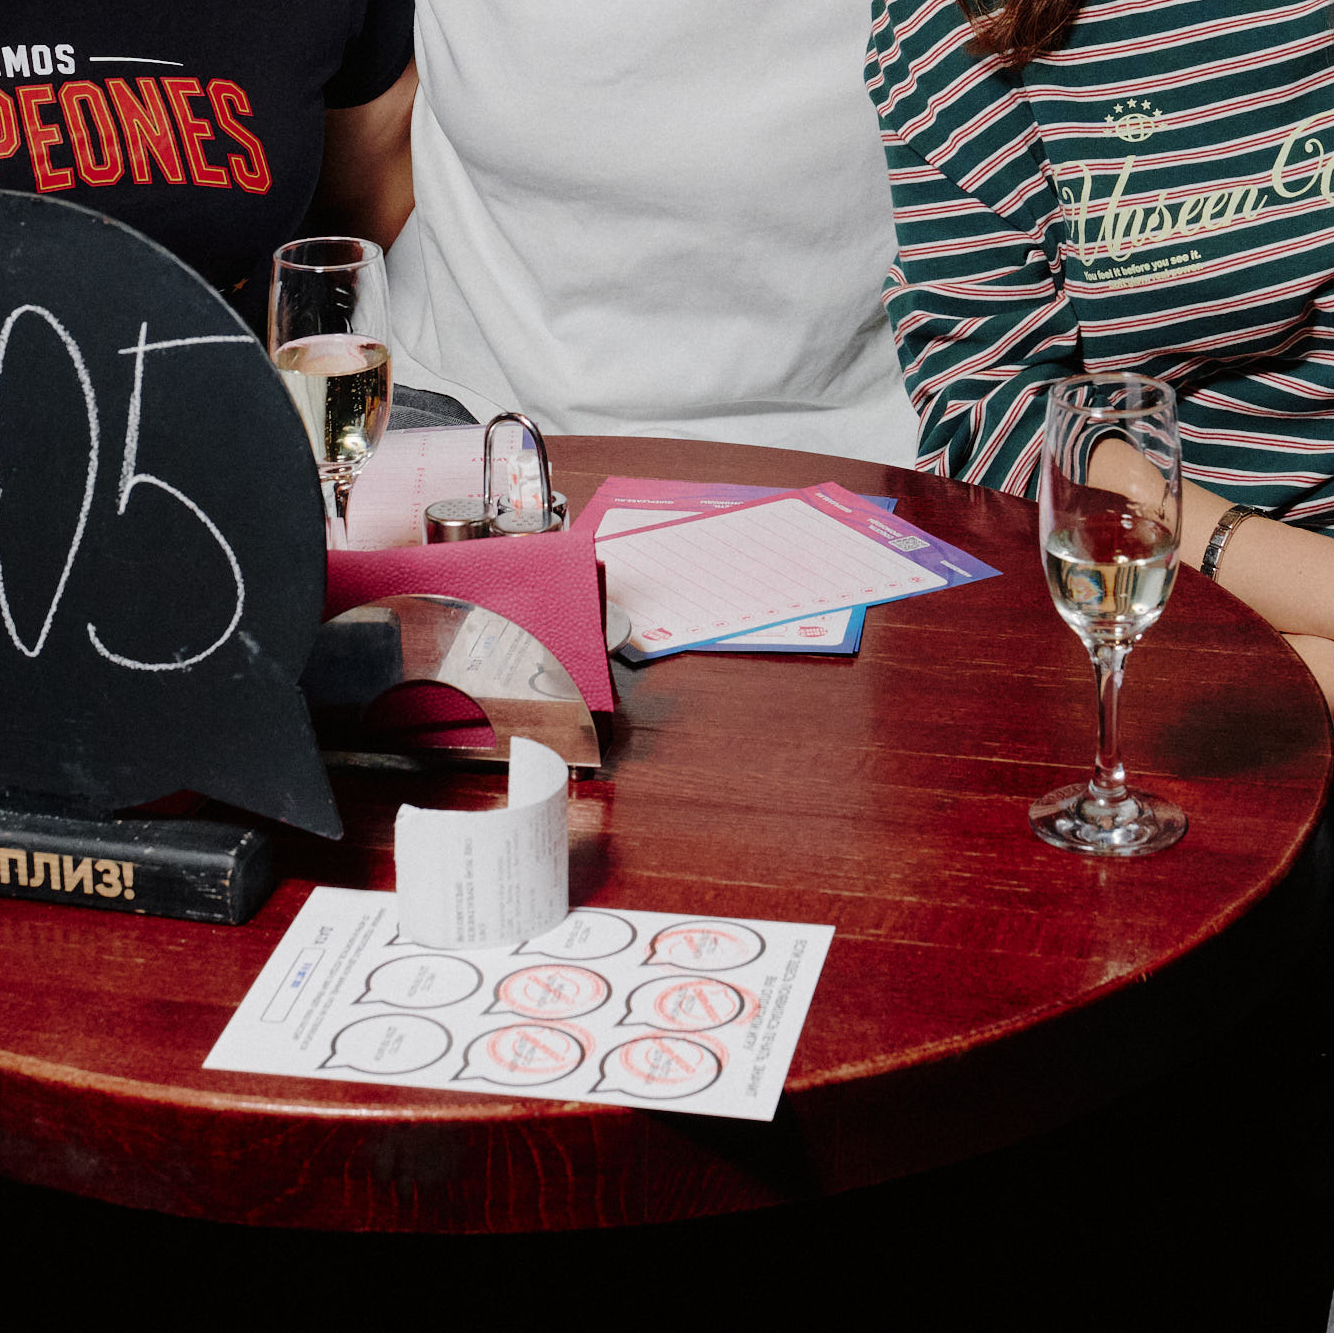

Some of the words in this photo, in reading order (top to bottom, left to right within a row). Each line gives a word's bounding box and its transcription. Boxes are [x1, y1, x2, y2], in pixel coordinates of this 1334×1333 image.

[1054, 155, 1268, 266] Unseen
[1122, 262, 1151, 276] before
[1151, 258, 1169, 272] you
[1170, 254, 1189, 264] see
